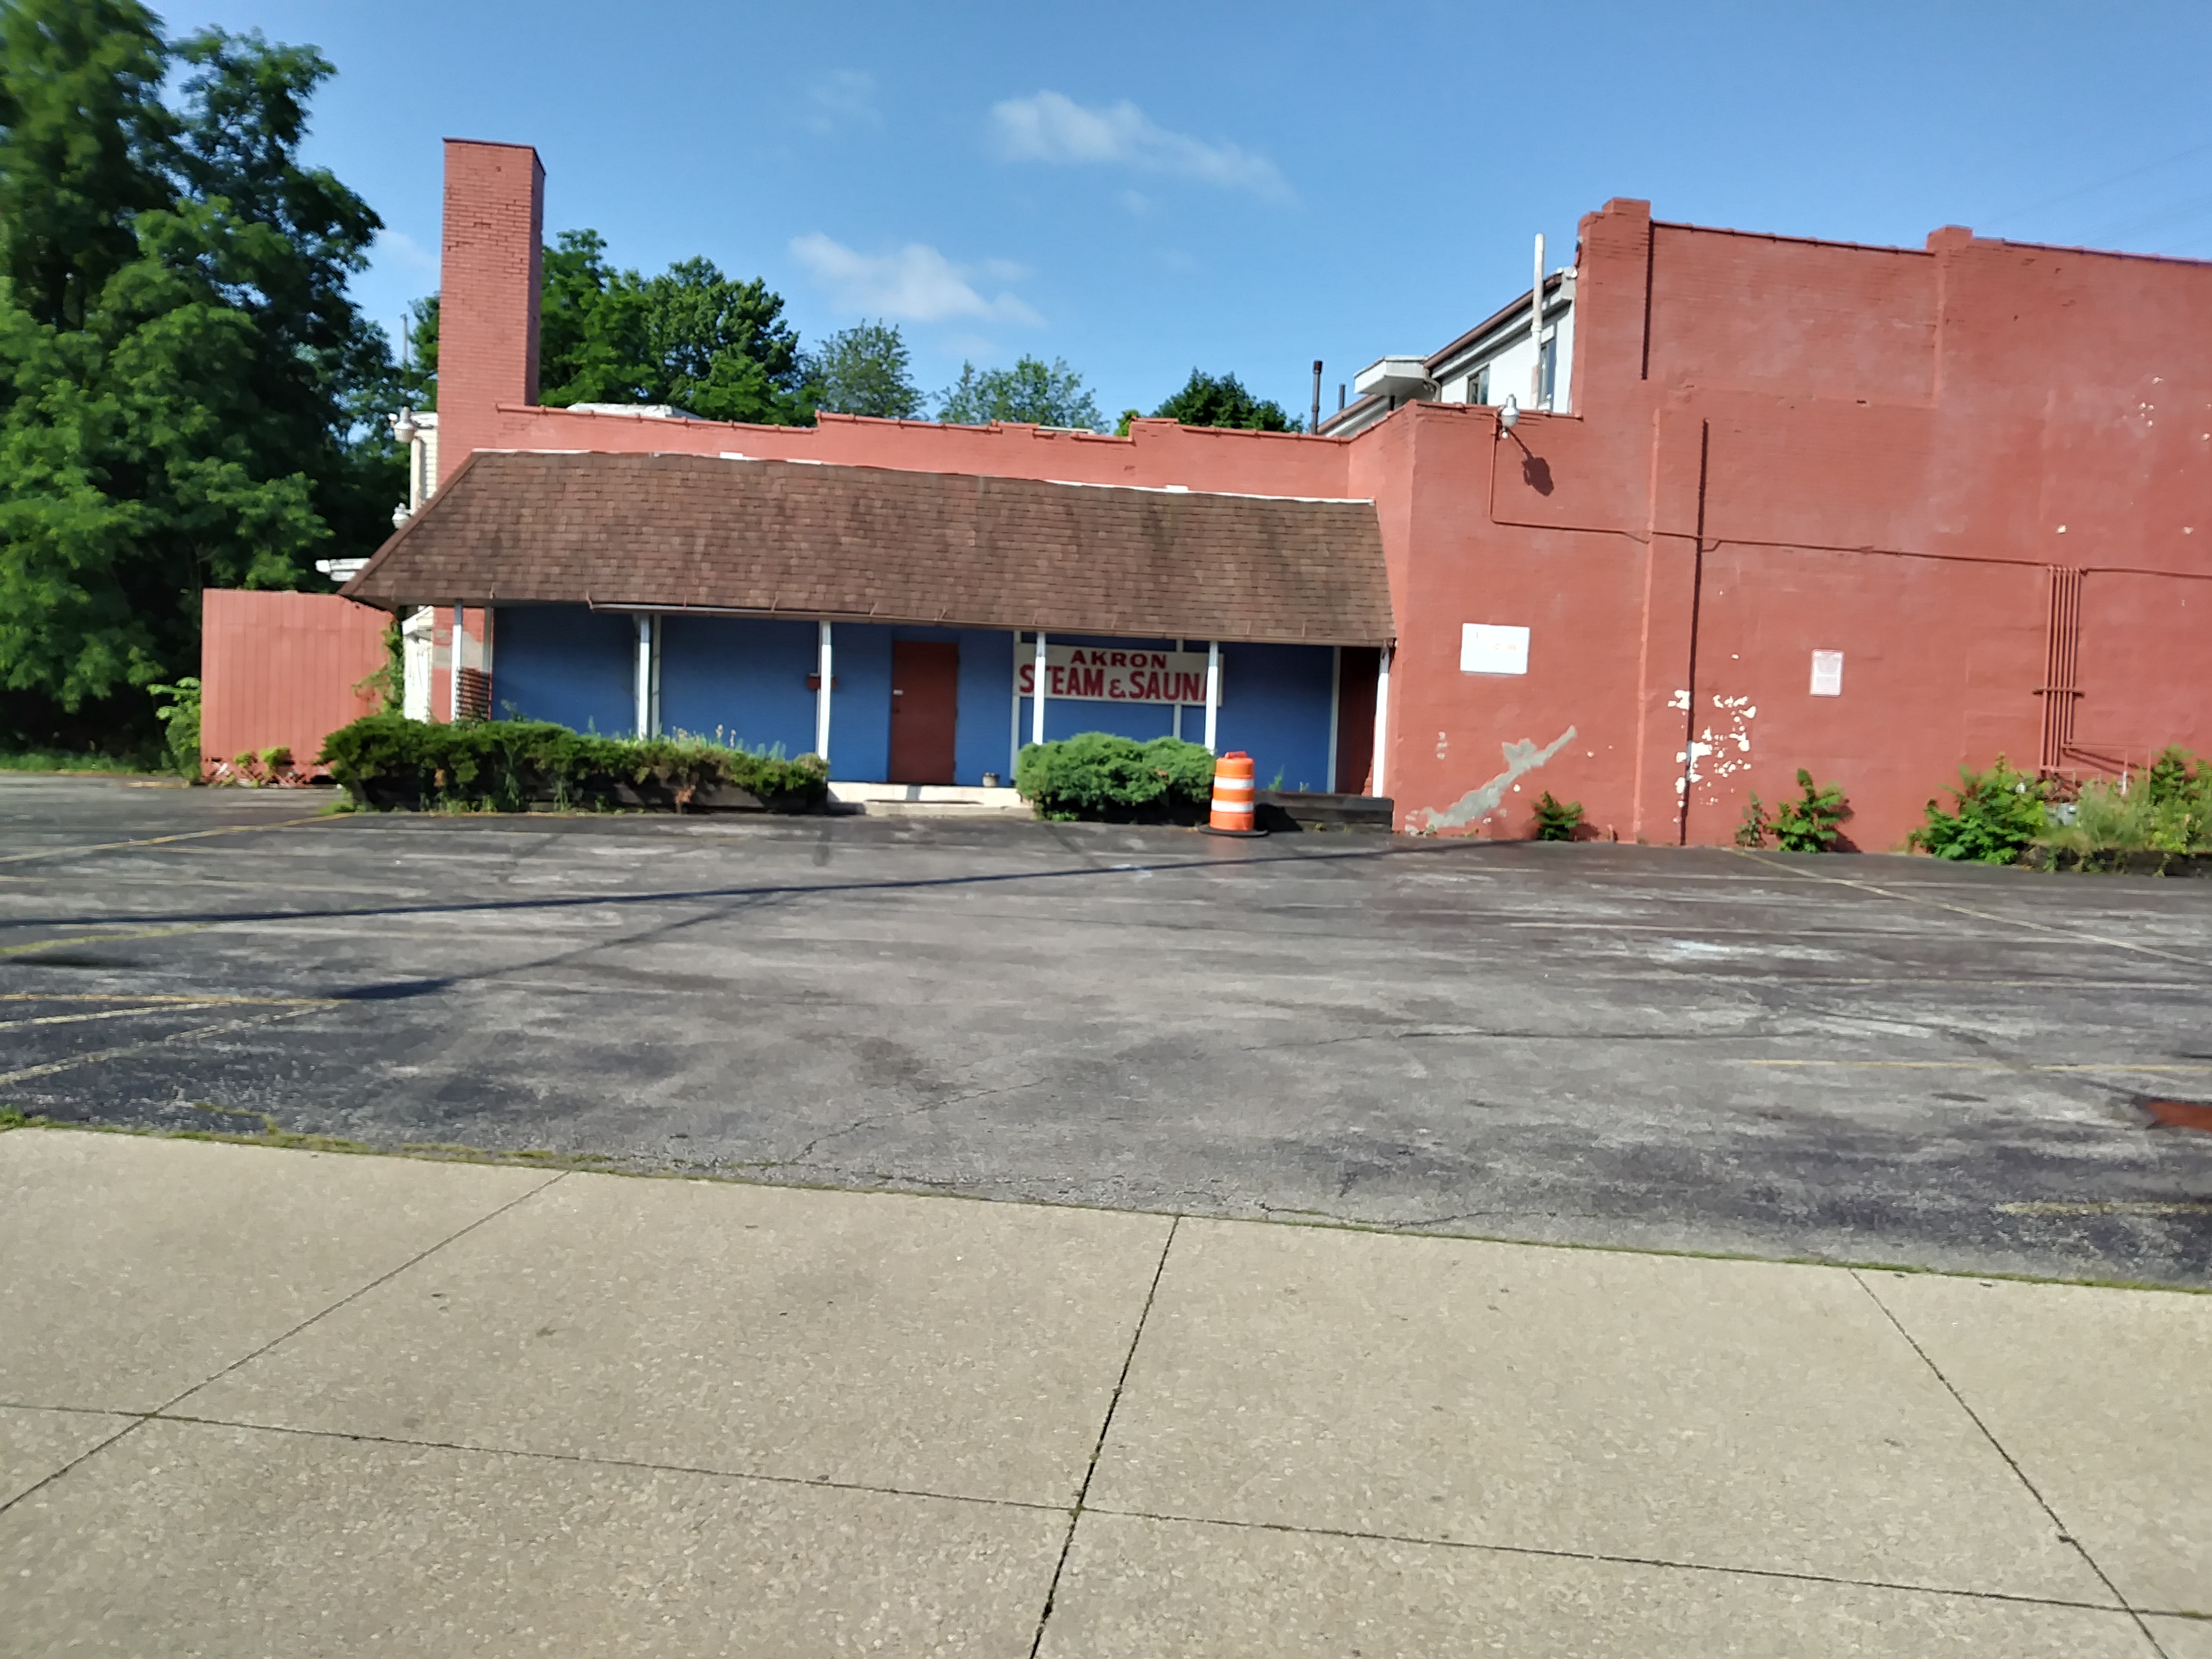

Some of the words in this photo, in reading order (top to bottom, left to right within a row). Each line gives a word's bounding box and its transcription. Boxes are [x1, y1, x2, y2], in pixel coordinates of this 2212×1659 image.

[1071, 650, 1167, 669] AKRON
[1019, 664, 1104, 697] SEAM
[1108, 679, 1127, 698] &
